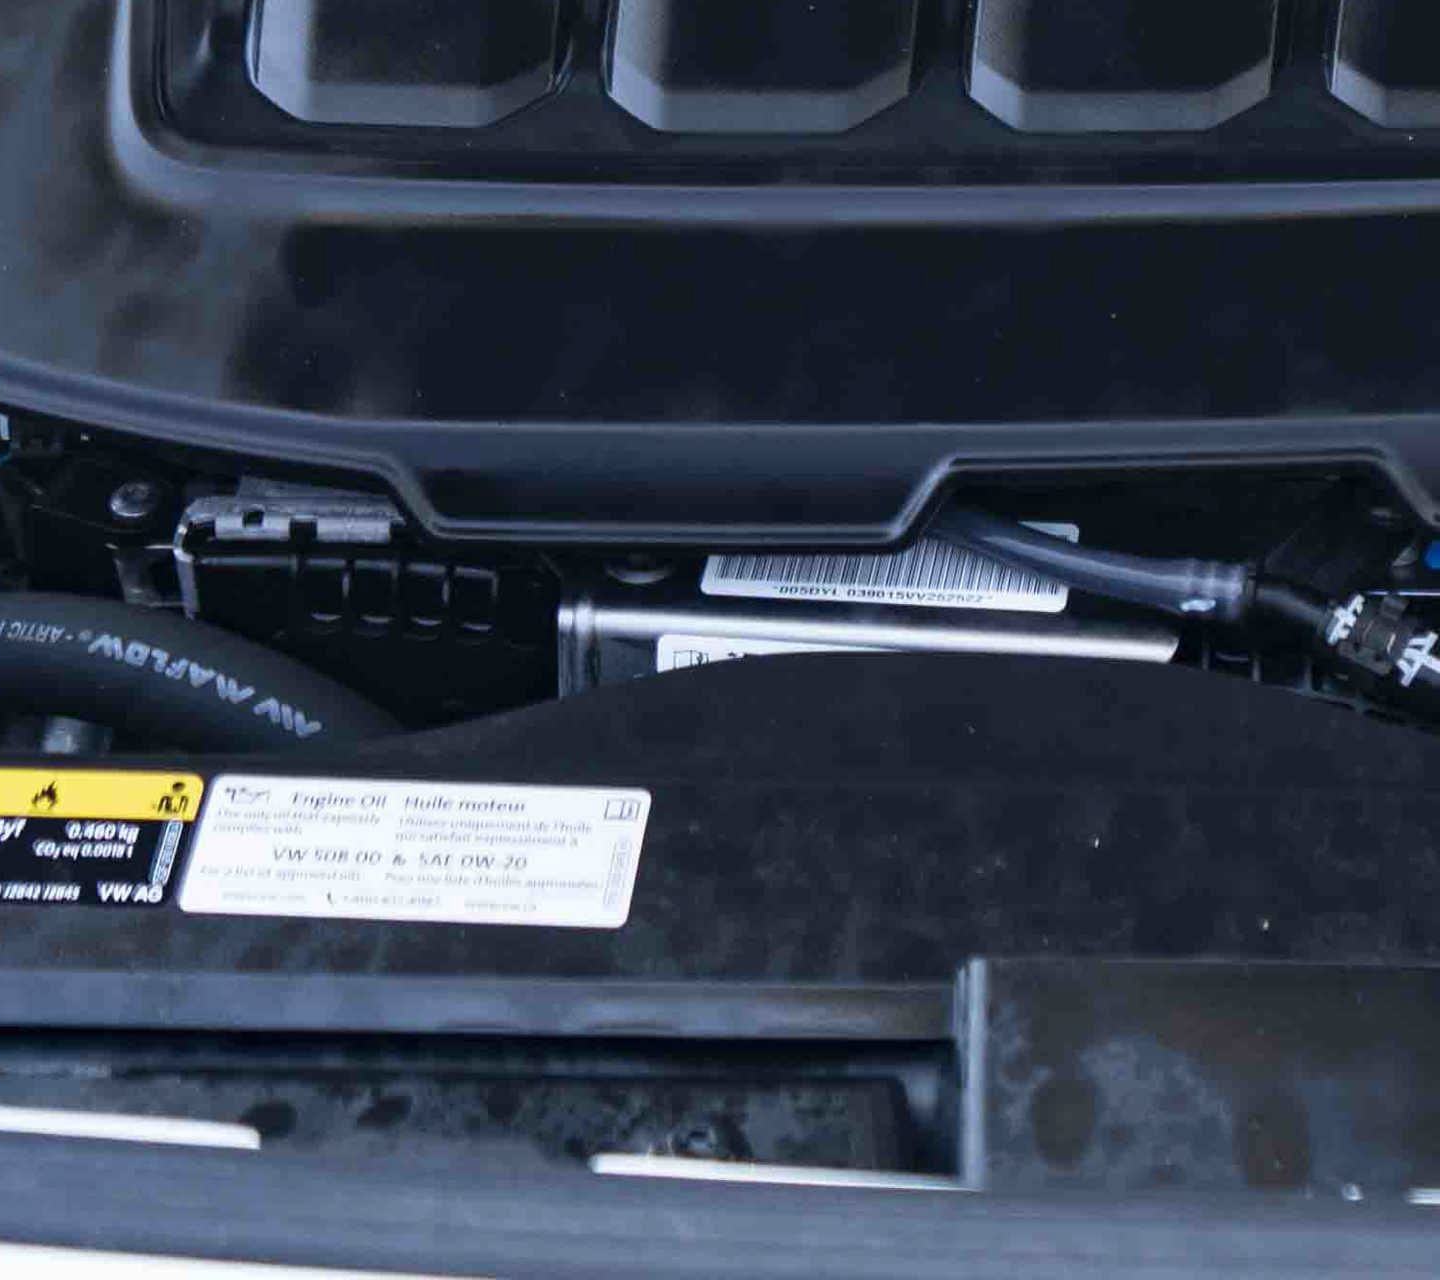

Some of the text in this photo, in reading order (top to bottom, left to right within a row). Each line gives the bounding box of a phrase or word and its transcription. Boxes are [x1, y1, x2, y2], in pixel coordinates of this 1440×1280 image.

[291, 791, 389, 810] Engine Oil
[404, 795, 527, 812] Huile moteur
[117, 824, 140, 845] kg
[273, 847, 310, 862] VW
[354, 850, 384, 866] 00
[419, 852, 452, 867] SAE
[97, 882, 163, 903] VW AG
